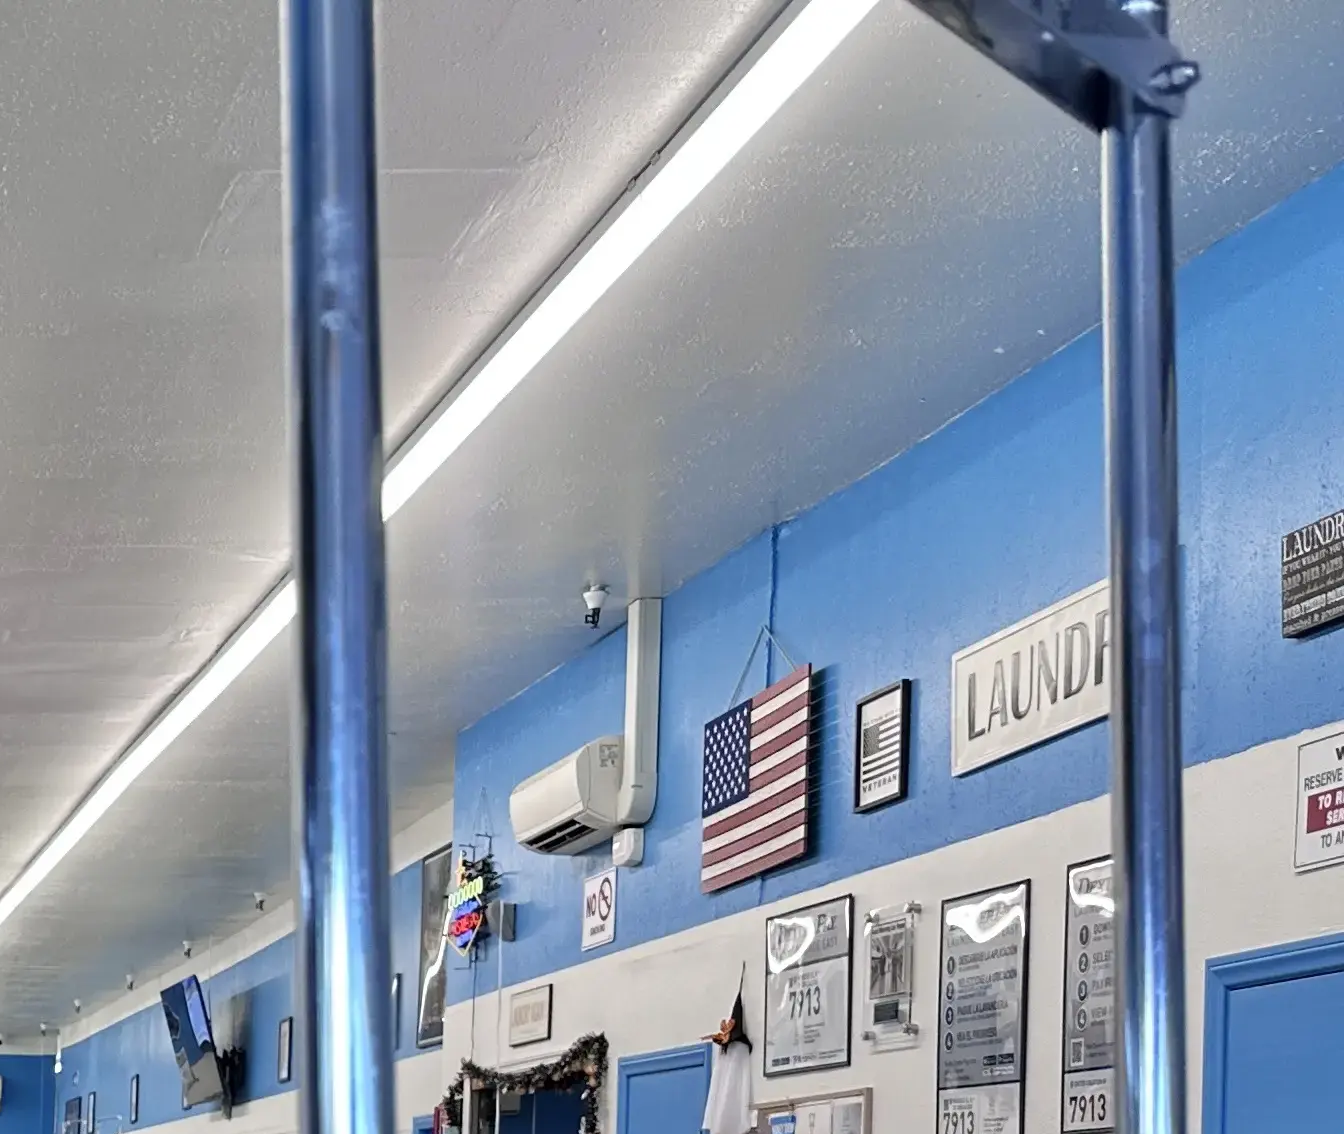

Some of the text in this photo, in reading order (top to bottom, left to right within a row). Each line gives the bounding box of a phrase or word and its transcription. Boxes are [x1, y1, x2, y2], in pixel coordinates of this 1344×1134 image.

[863, 774, 897, 793] VETERAN
[1304, 767, 1343, 792] RESERVE
[1317, 793, 1332, 810] TO
[1321, 834, 1332, 848] TO
[586, 893, 596, 918] NO
[789, 986, 820, 1020] 7913
[1069, 1094, 1106, 1123] 7913
